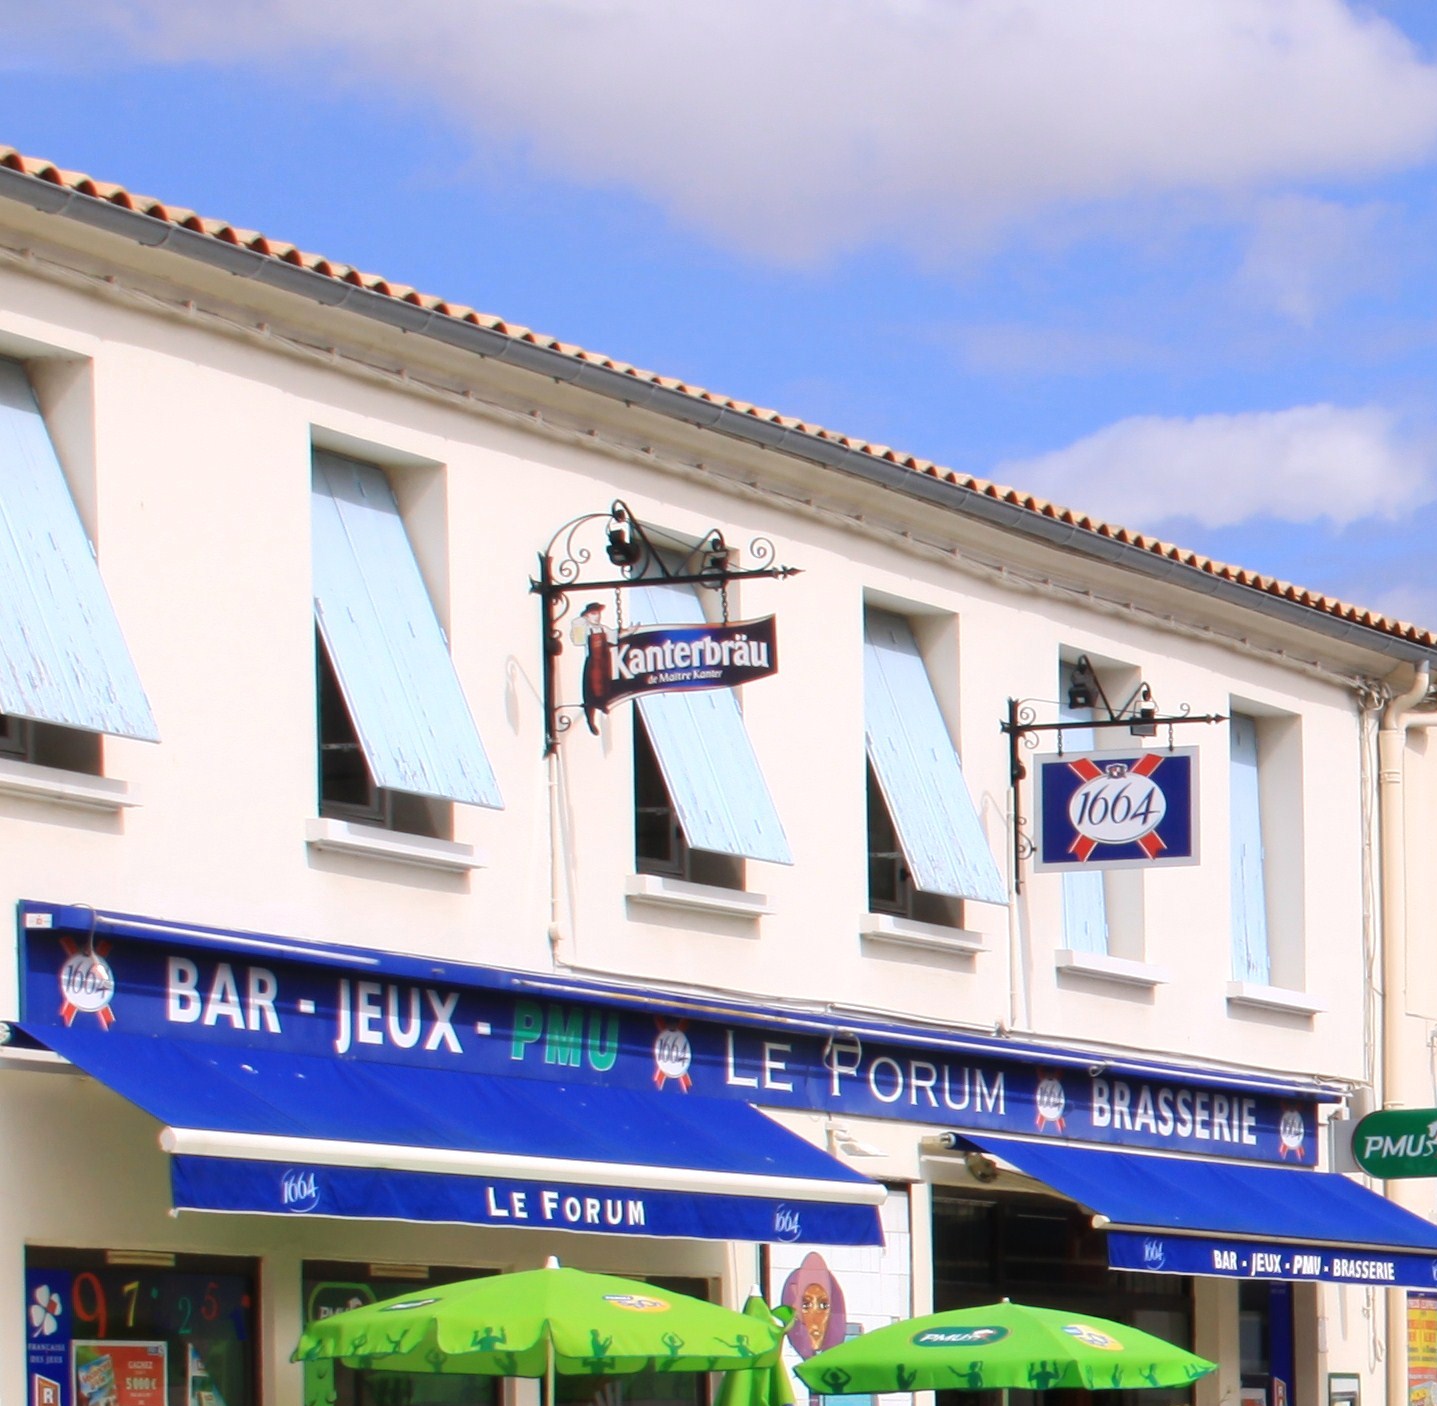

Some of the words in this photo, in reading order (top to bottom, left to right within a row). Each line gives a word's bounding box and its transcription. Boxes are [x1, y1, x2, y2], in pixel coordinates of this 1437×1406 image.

[610, 634, 769, 680] Kanterbräu
[648, 674, 658, 685] de
[692, 669, 723, 680] Kanter
[1077, 782, 1160, 826] 1664
[166, 956, 281, 1034] BAR
[335, 977, 464, 1054] JEUX
[511, 1000, 620, 1072] PMU
[656, 1033, 690, 1063] 1664
[726, 1030, 793, 1092] LE
[829, 1041, 1006, 1115] FORUM
[1092, 1078, 1257, 1145] BRASSERIE
[1364, 1136, 1425, 1159] PMU
[283, 1172, 318, 1205] 1664
[775, 1205, 800, 1234] 1664
[1213, 1249, 1237, 1270] BAR
[1252, 1250, 1282, 1276] JEUX
[1293, 1255, 1321, 1276] PMU
[1333, 1258, 1395, 1281] BRASSERIE
[72, 1272, 107, 1338] 9
[920, 1333, 972, 1342] PMU
